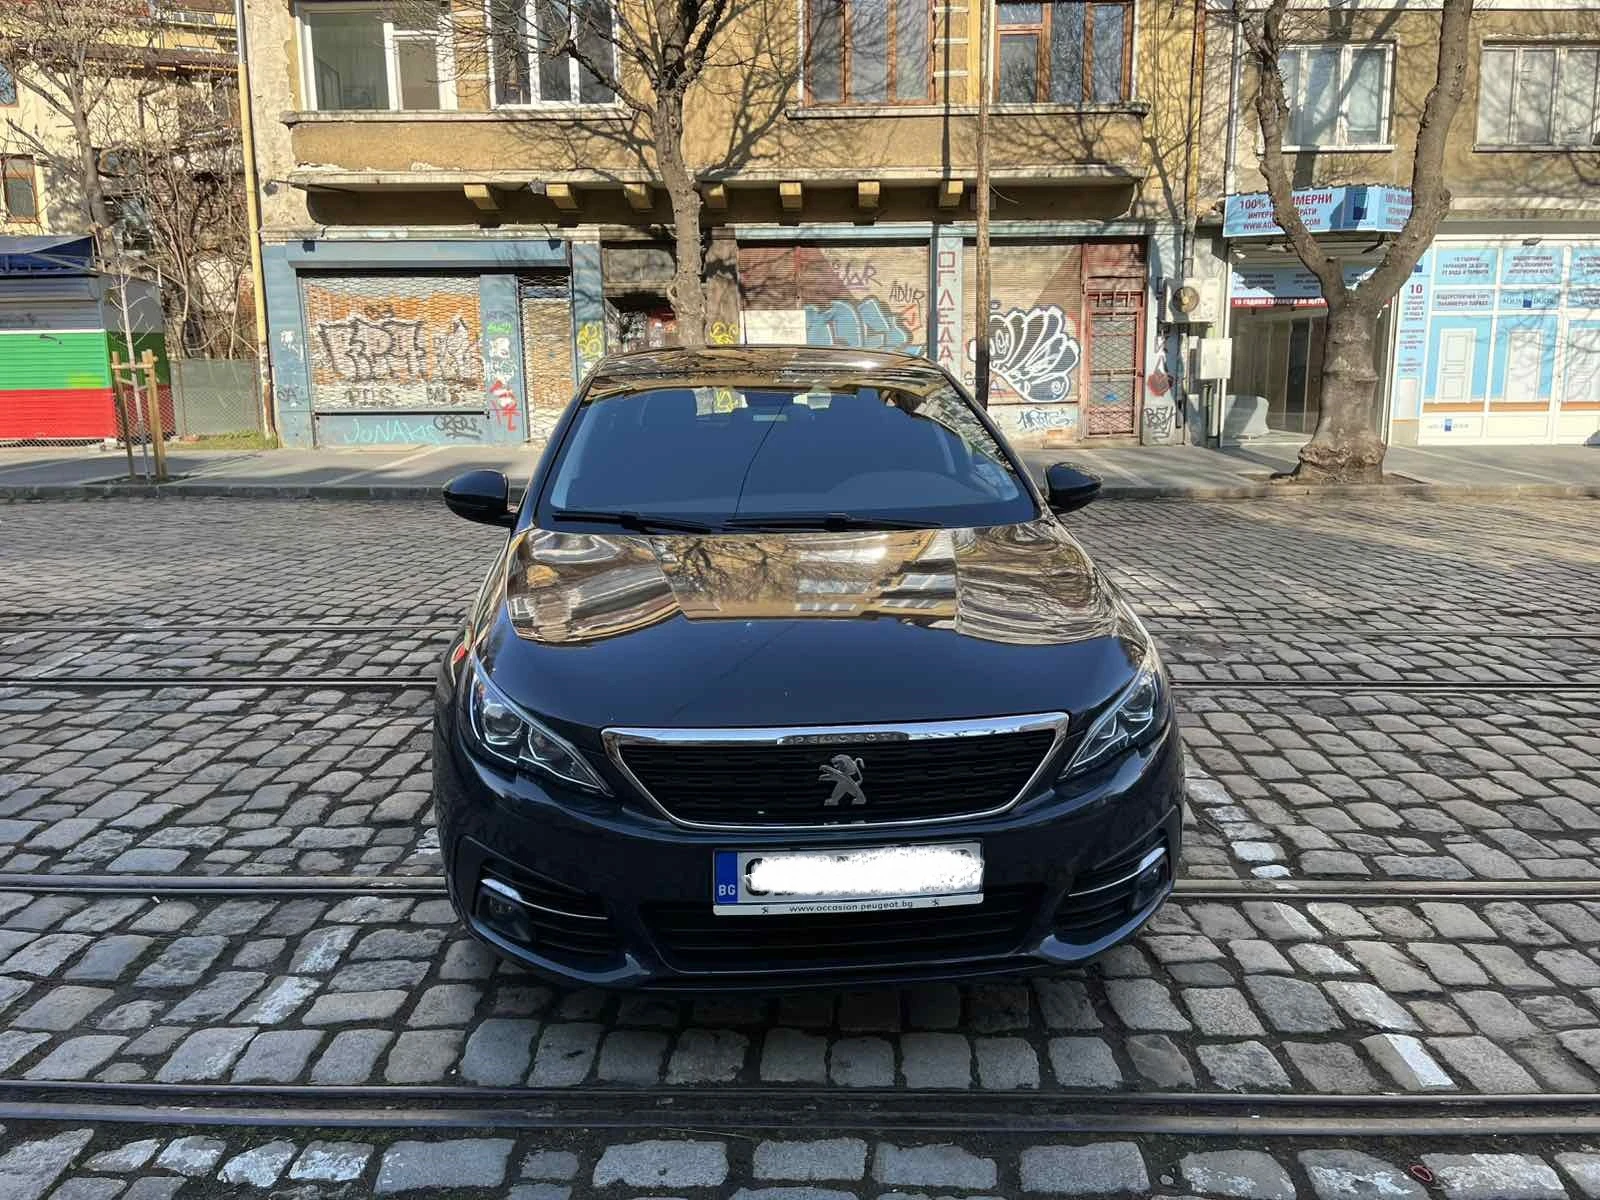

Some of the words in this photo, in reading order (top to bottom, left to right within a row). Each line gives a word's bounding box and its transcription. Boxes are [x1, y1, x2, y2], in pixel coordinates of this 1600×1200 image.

[1240, 198, 1266, 210] 100%
[1410, 284, 1423, 294] 10
[717, 884, 737, 896] BG
[789, 900, 913, 913] www.occasion.peugeot.bg
